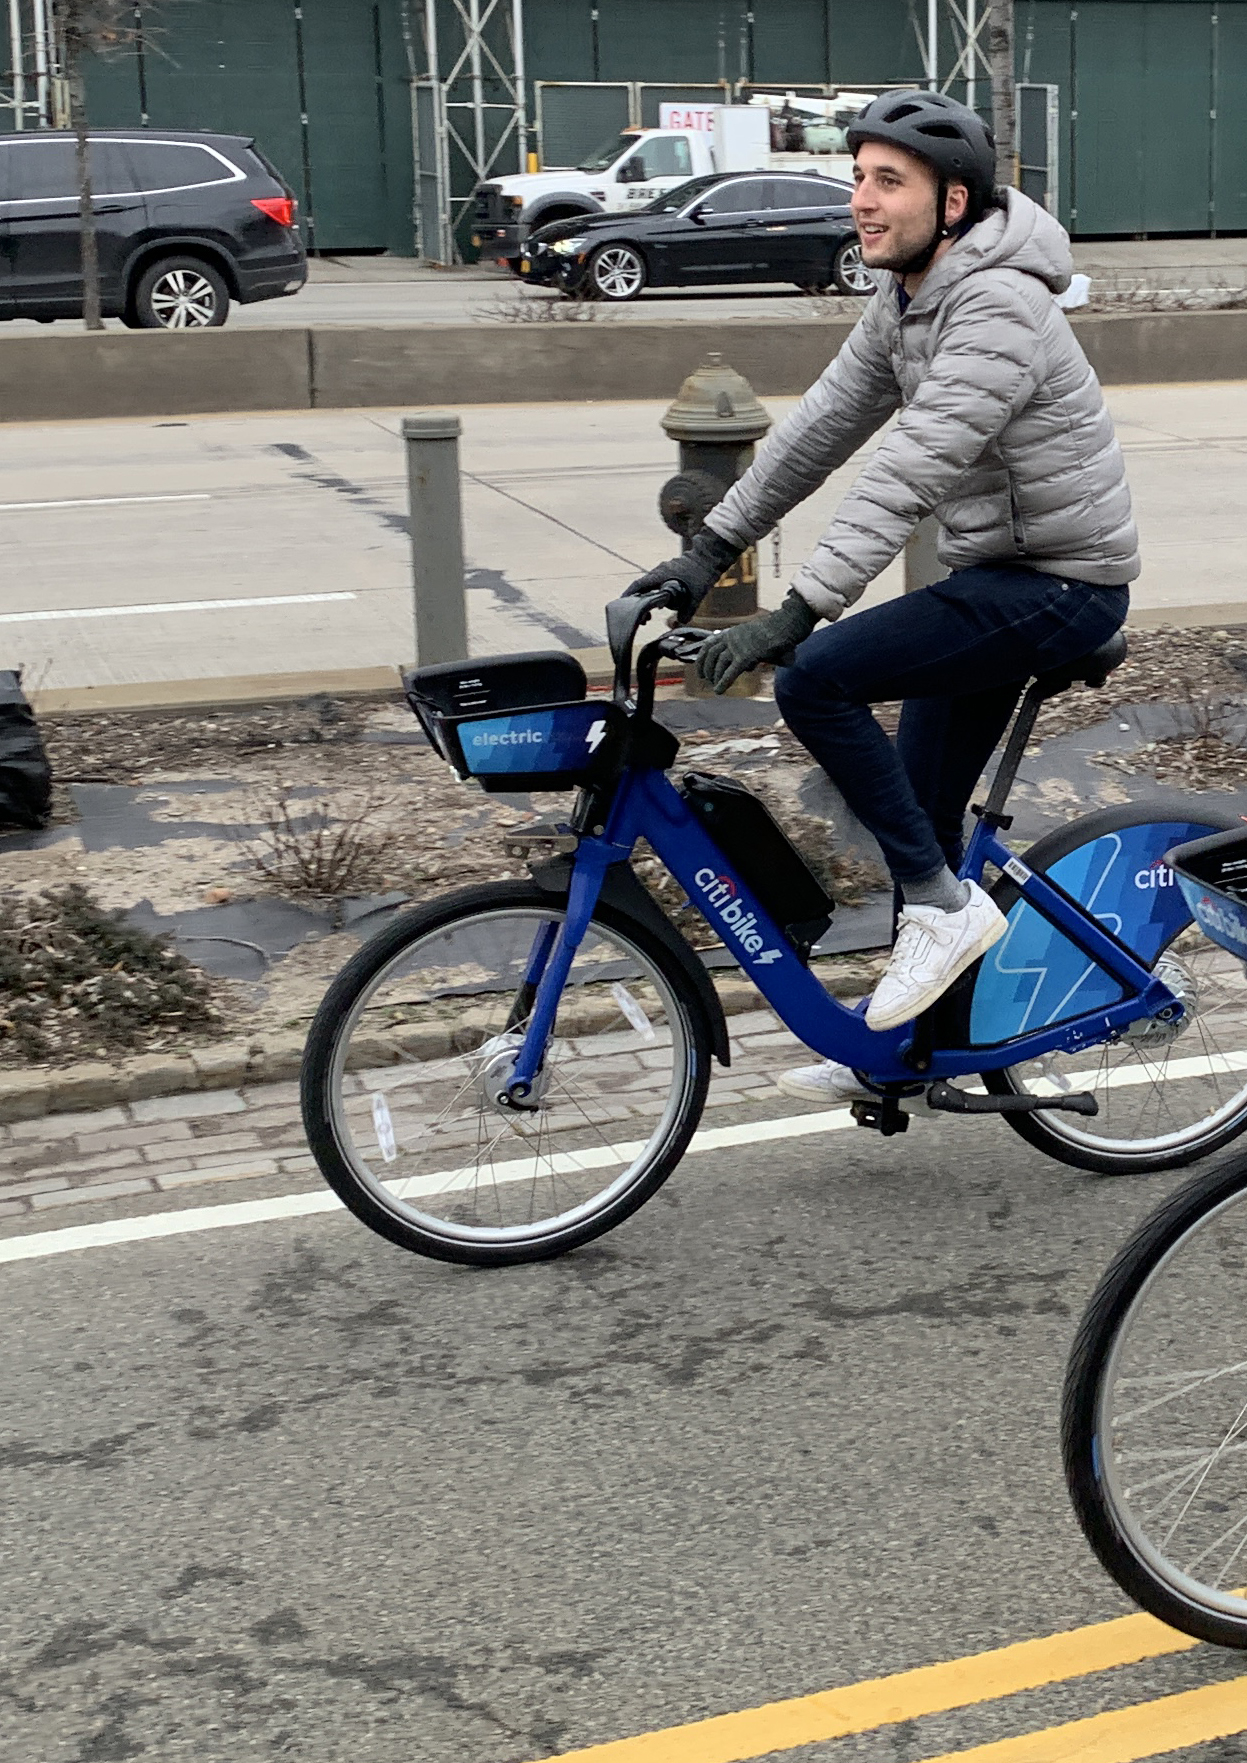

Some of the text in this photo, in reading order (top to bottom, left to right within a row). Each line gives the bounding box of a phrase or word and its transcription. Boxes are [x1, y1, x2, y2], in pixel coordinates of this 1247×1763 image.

[669, 110, 714, 131] GATE
[472, 729, 543, 747] electric
[1134, 861, 1175, 890] citi
[694, 867, 764, 955] citi bike
